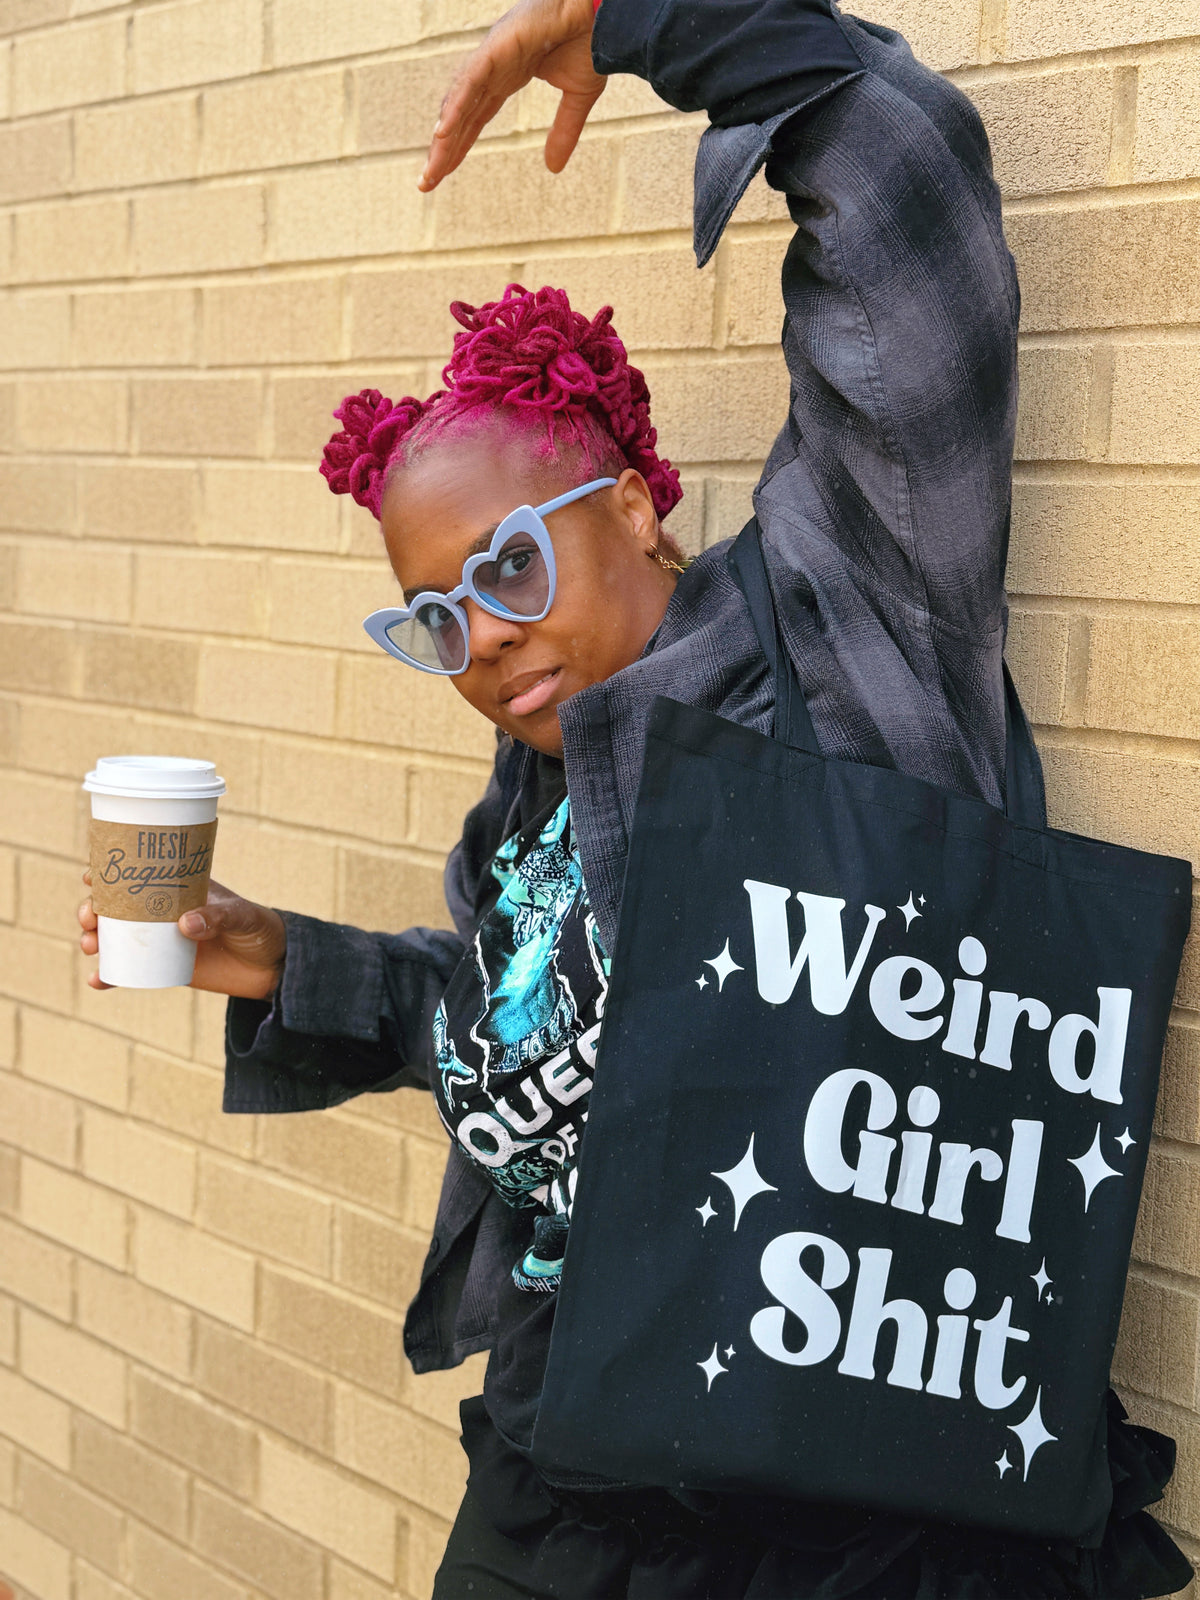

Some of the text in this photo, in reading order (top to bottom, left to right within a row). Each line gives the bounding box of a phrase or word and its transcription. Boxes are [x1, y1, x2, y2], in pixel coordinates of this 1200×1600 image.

[100, 843, 212, 895] Baguette
[137, 832, 188, 860] FRESH
[743, 878, 1133, 1105] Weird
[539, 1122, 580, 1168] OF
[803, 1068, 1044, 1244] Girl
[527, 1277, 556, 1292] SHE
[749, 1231, 1030, 1410] Shit
